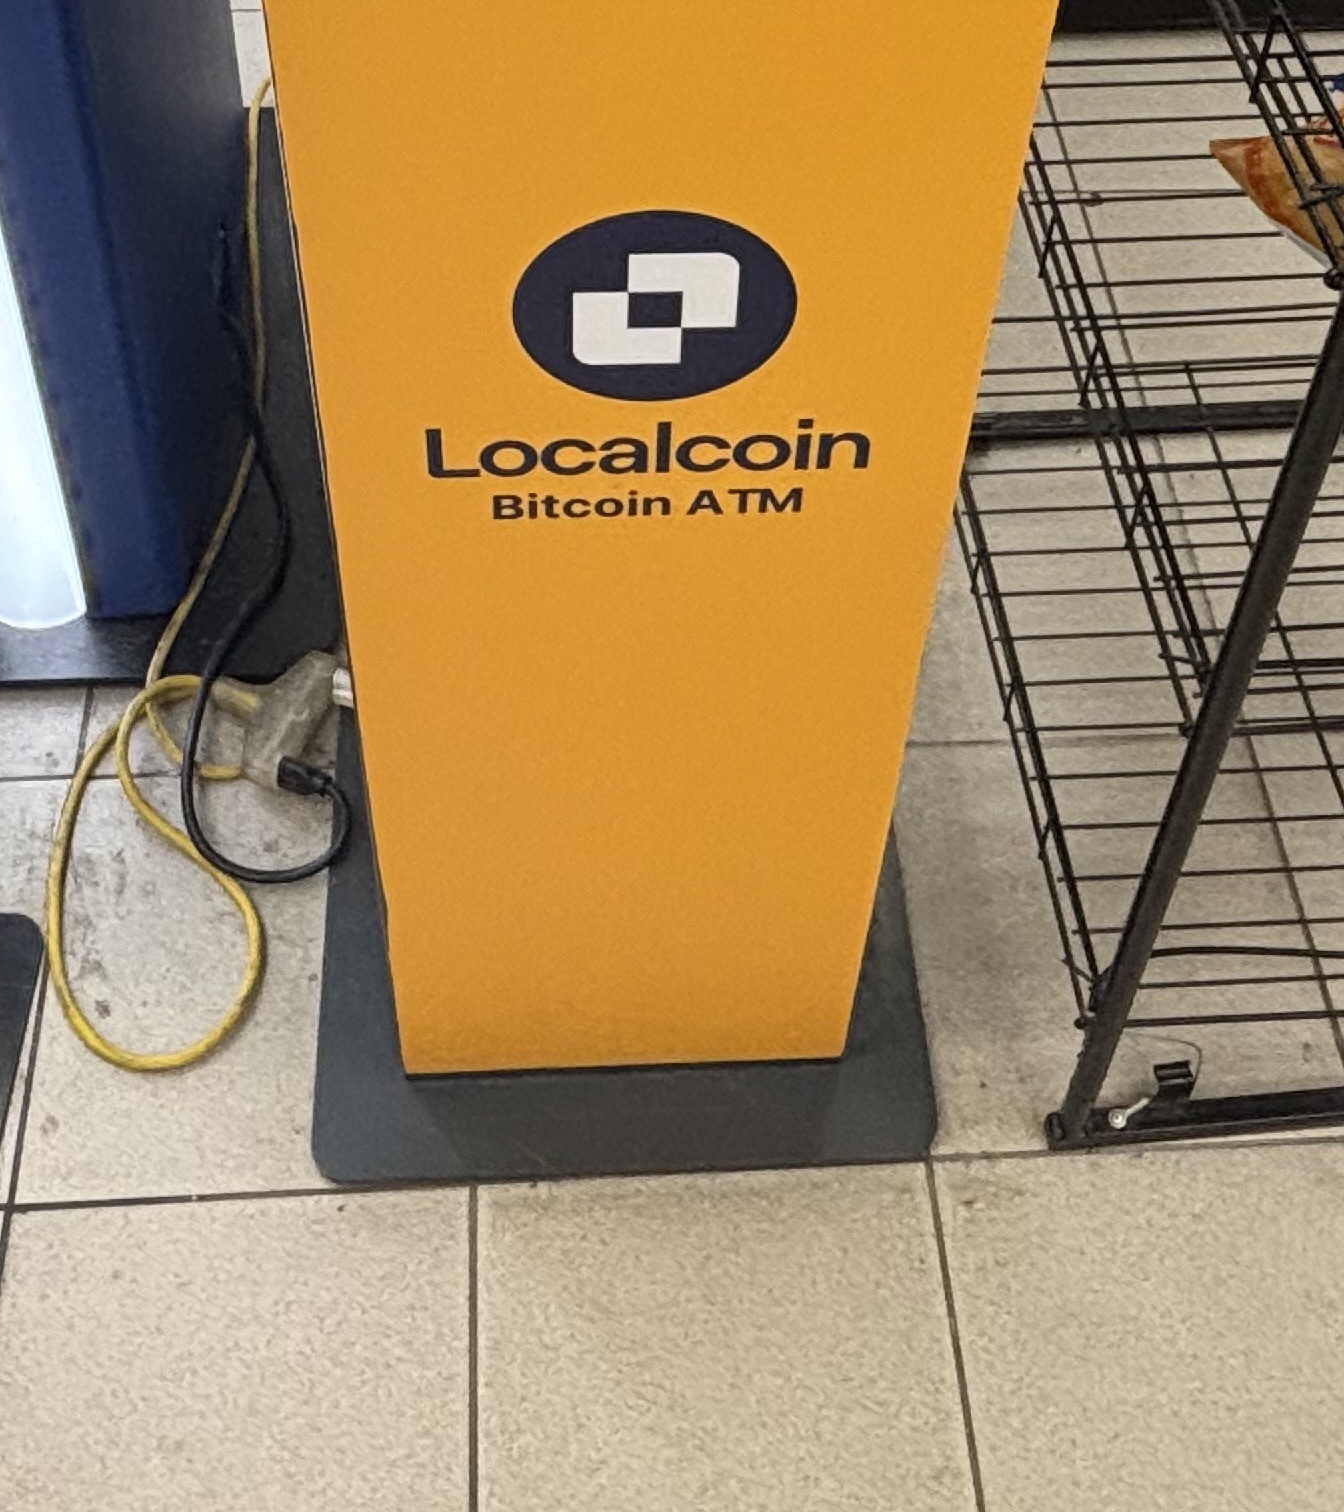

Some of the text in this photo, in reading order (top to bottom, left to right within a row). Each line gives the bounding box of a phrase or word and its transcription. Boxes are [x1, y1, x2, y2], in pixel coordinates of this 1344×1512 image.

[426, 418, 871, 478] Localcoin
[492, 488, 803, 520] Bitcoin ATM
